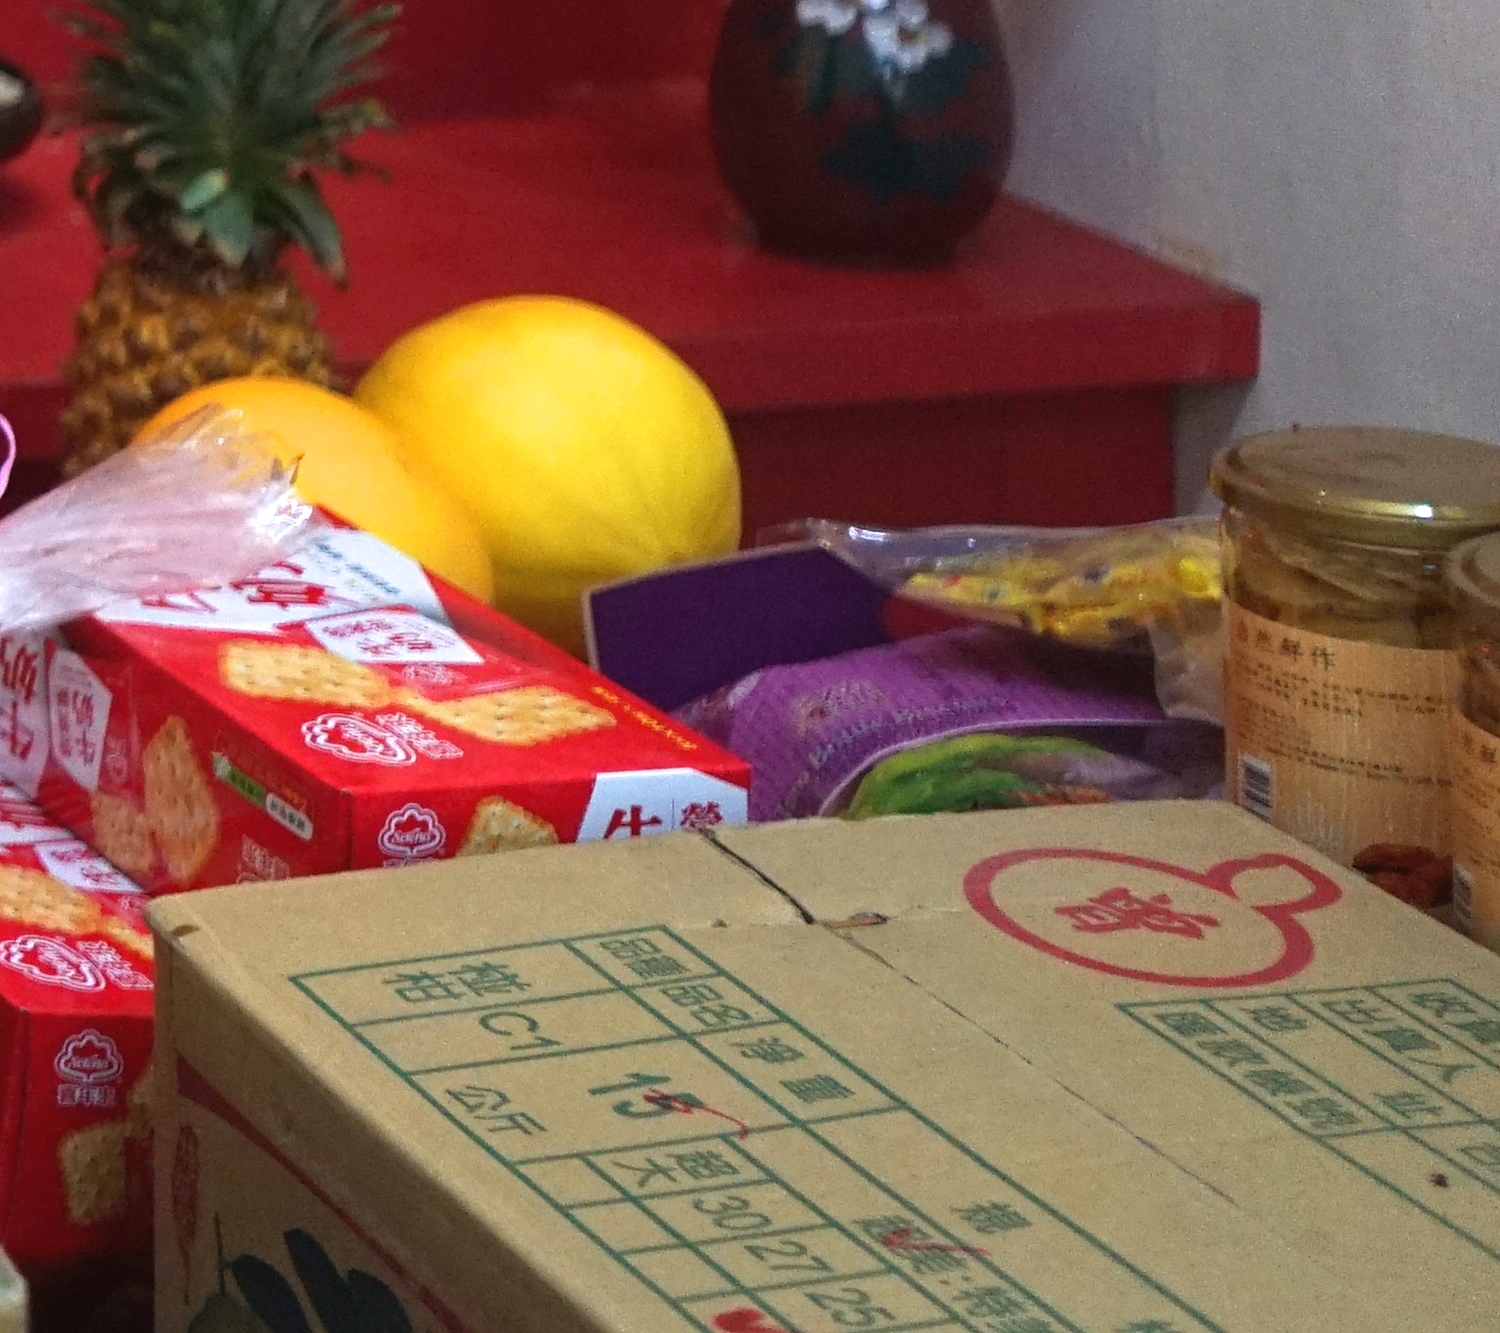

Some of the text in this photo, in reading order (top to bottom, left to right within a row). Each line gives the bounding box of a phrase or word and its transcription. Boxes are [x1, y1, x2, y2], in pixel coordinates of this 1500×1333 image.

[381, 961, 532, 1003] 椪柑
[660, 983, 755, 1029] 品名
[478, 1010, 564, 1051] C1
[729, 1036, 856, 1104] 淨重
[445, 1084, 548, 1136] 公斤
[609, 1149, 741, 1188] 超大
[693, 1195, 773, 1231] 30
[743, 1239, 835, 1272] 27
[803, 1286, 897, 1328] 25
